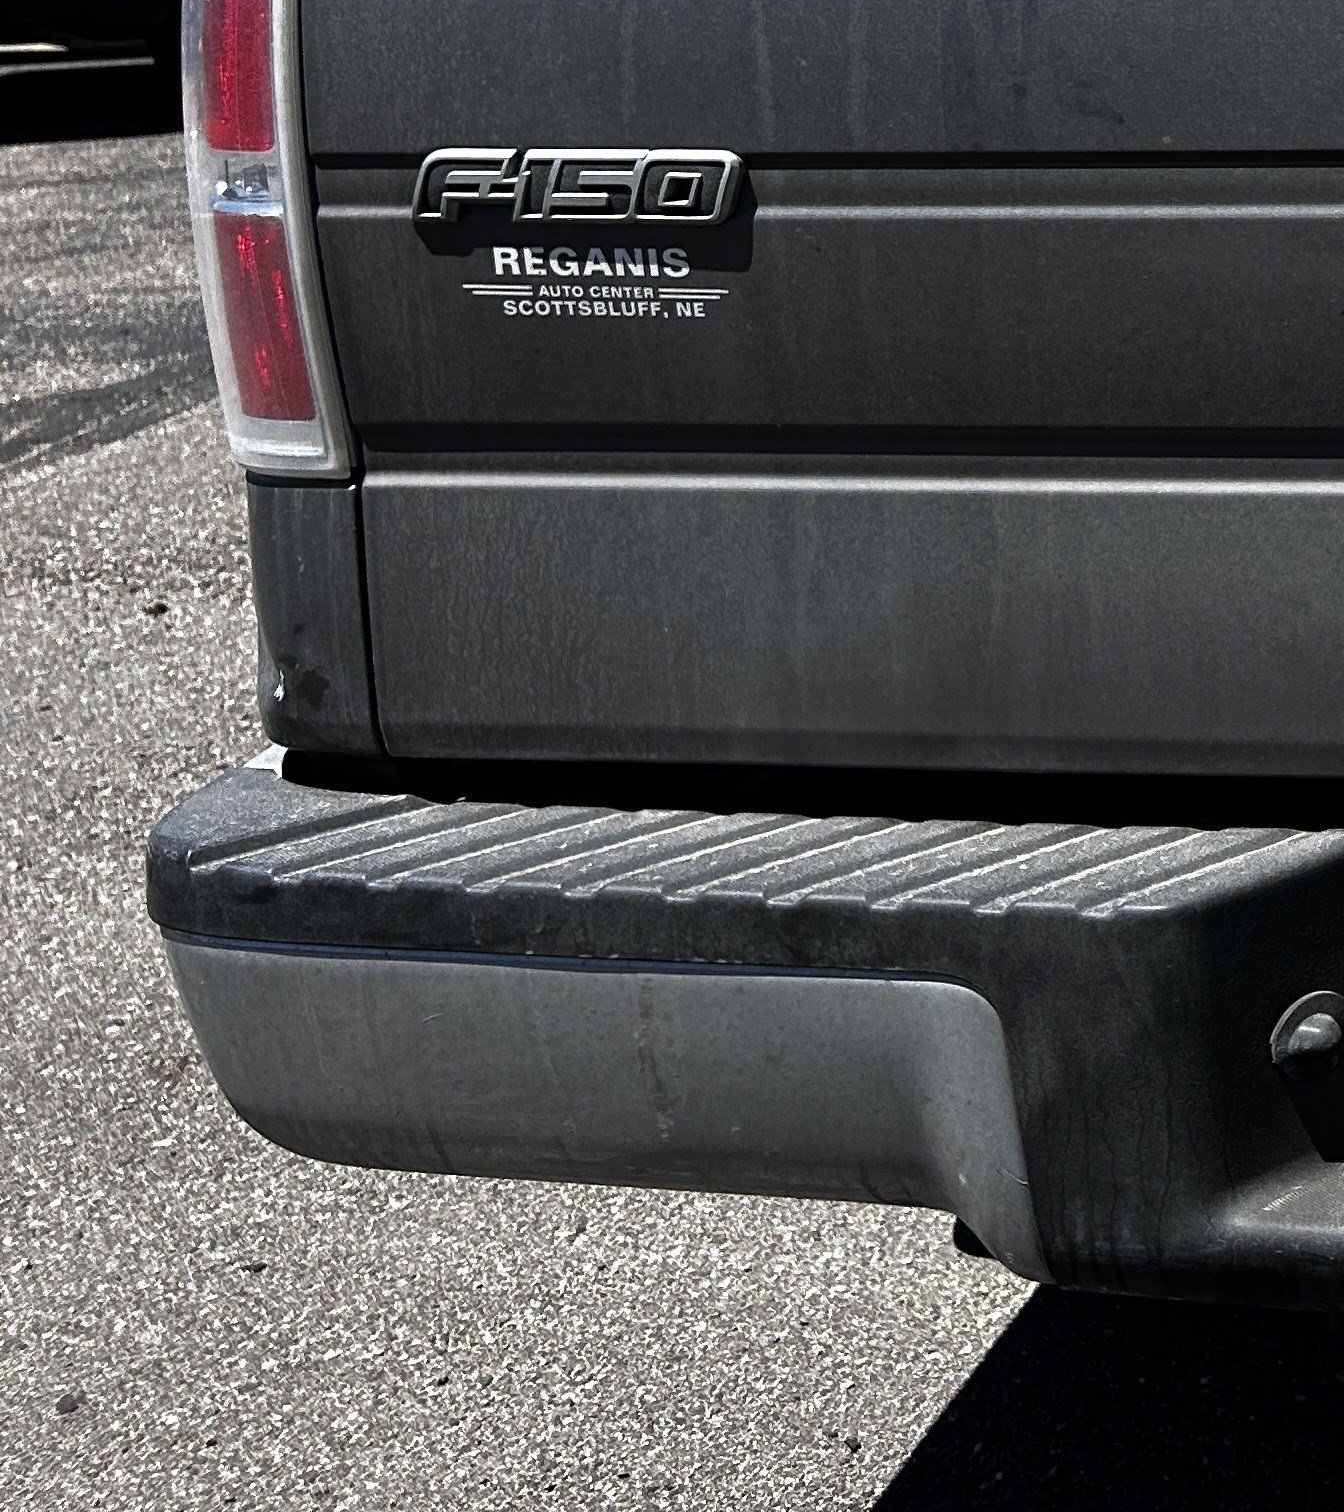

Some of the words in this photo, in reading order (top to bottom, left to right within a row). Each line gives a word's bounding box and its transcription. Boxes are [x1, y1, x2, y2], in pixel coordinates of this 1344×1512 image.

[411, 147, 746, 225] F-150
[492, 246, 691, 278] REGANIS
[539, 285, 584, 298] AUTO
[589, 286, 655, 299] CENTER
[502, 299, 669, 318] SCOTTSBLUFF,
[676, 301, 706, 318] NE
